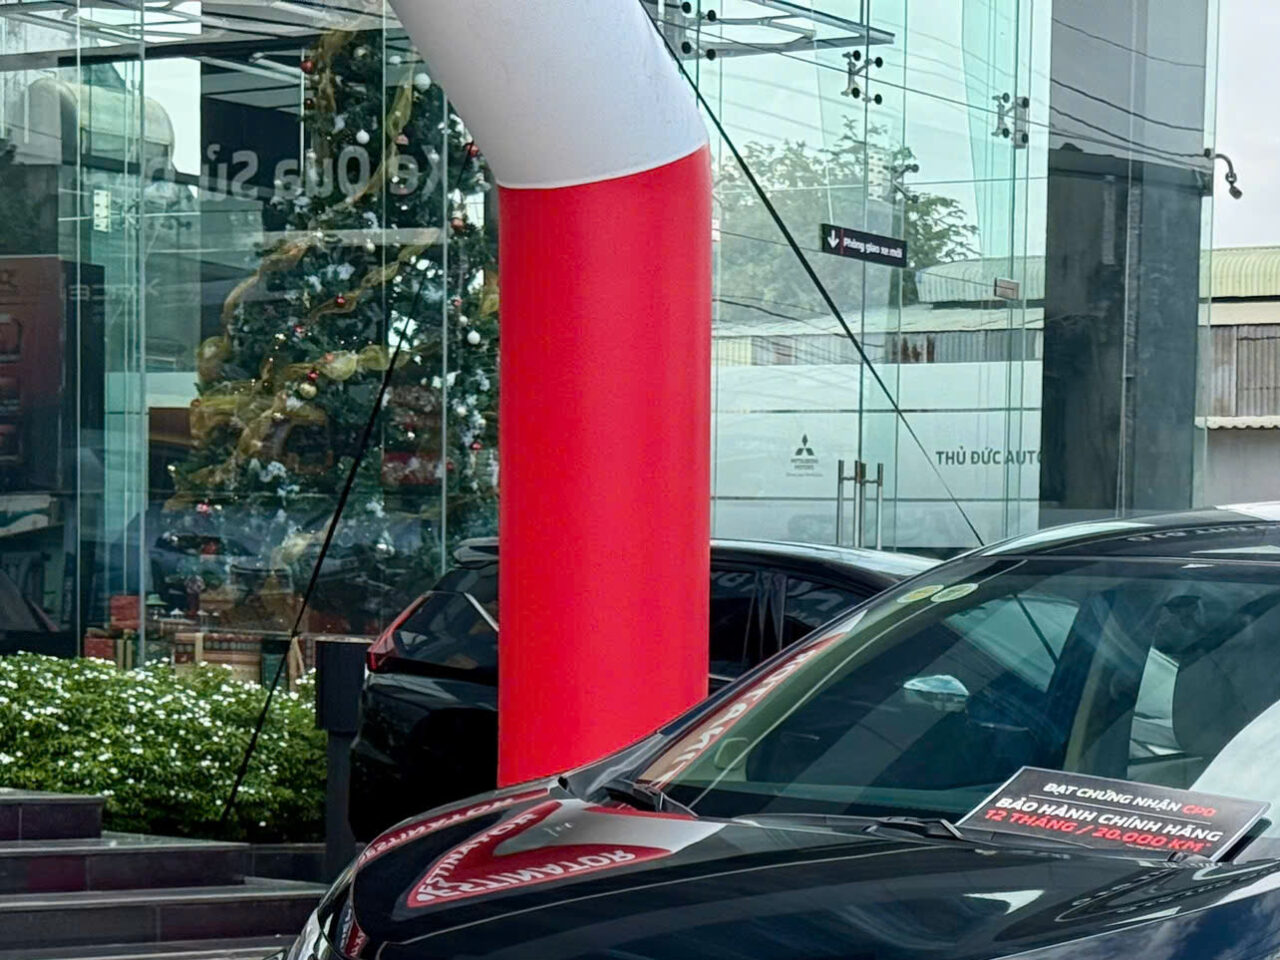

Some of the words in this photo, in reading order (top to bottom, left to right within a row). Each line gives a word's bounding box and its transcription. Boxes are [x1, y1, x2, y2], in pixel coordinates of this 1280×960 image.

[935, 445, 965, 466] THỦ
[970, 446, 1001, 465] ĐỨC
[1043, 782, 1078, 796] ĐẠT
[1132, 796, 1183, 812] NHẬN
[1182, 804, 1217, 817] CPO
[985, 809, 1008, 821] 12
[1009, 812, 1079, 832] THÁNG
[1092, 826, 1168, 847] 20.000
[995, 796, 1039, 812] BẢO
[1037, 803, 1098, 822] HÀNH
[1098, 813, 1162, 833] CHÍNH
[1161, 822, 1224, 842] HÃNG
